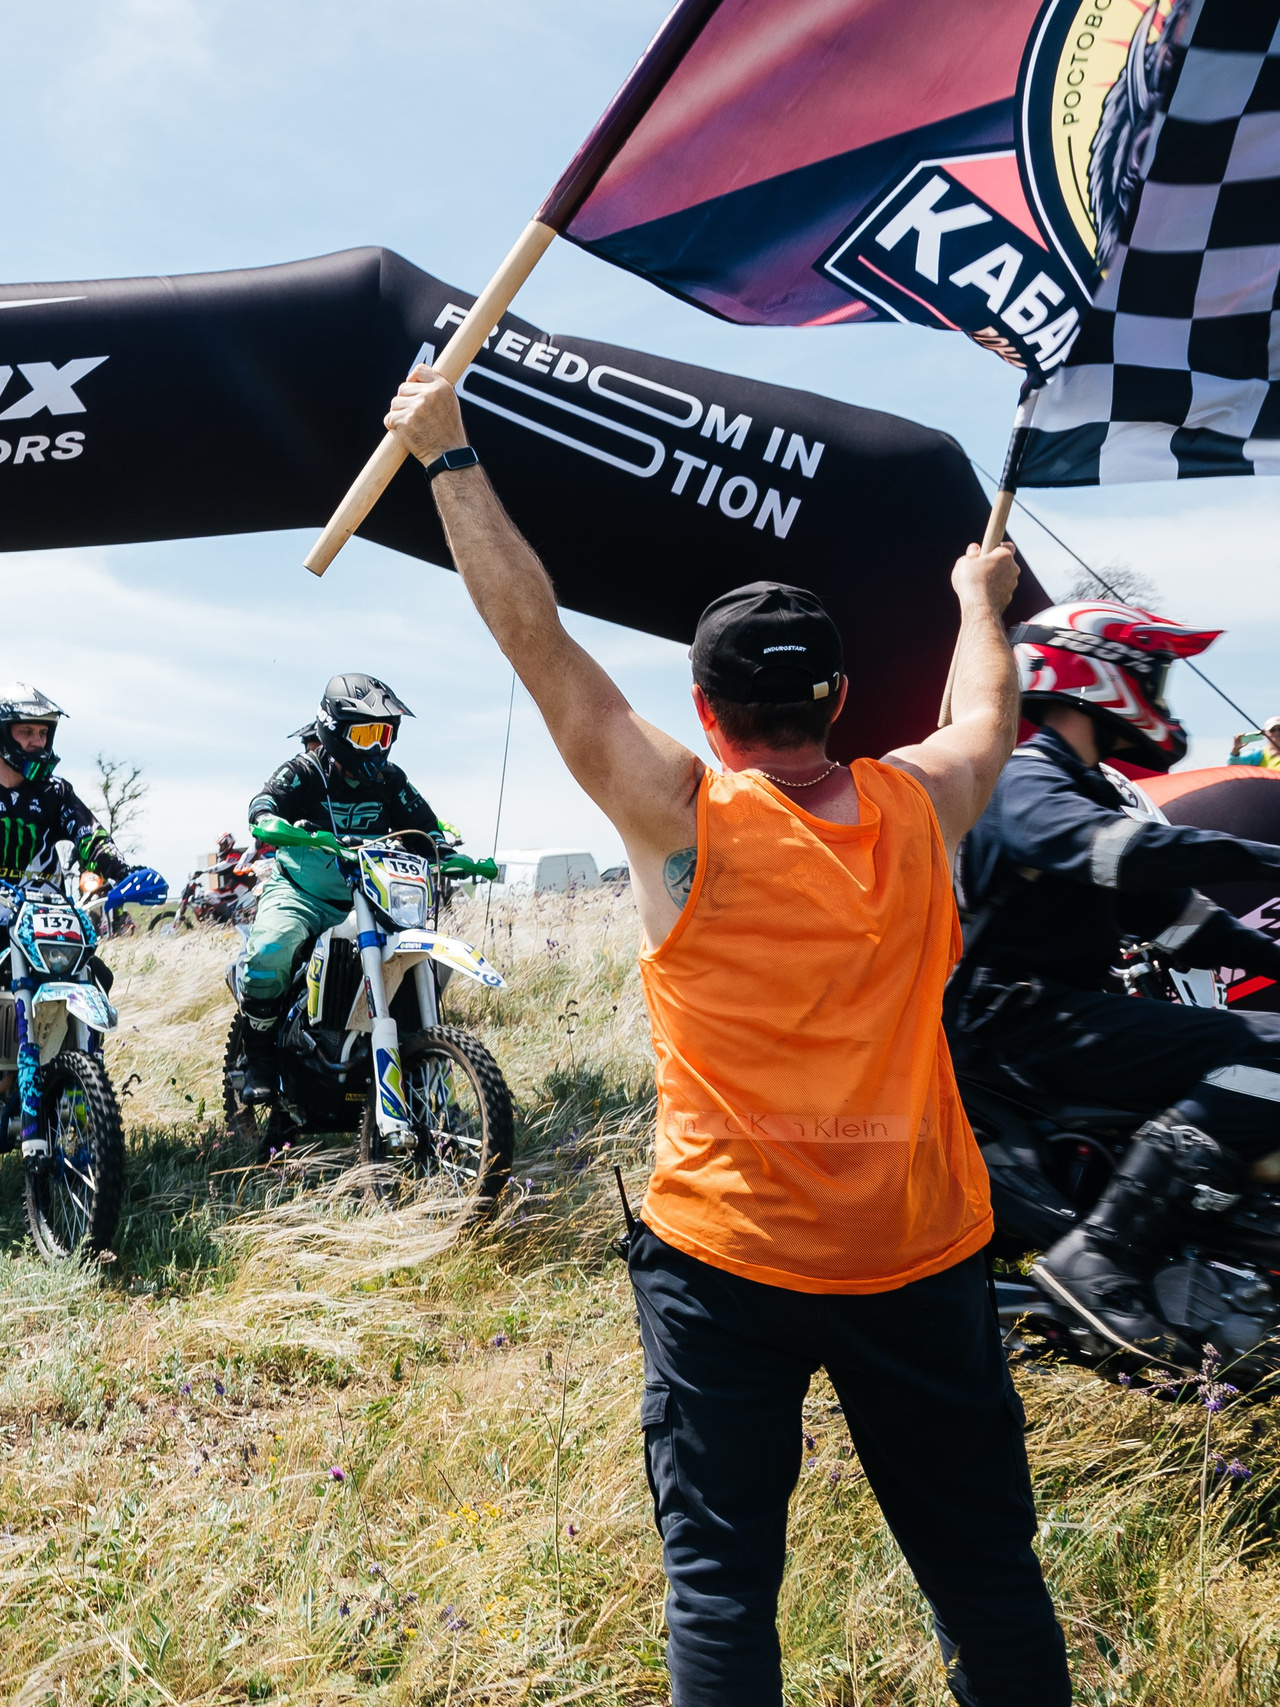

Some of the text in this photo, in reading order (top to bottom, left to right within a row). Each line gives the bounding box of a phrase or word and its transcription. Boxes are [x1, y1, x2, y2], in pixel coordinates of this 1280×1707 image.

[762, 426, 826, 479] IN
[389, 860, 420, 876] 139
[40, 916, 74, 930] 137
[815, 1118, 888, 1138] Klein
